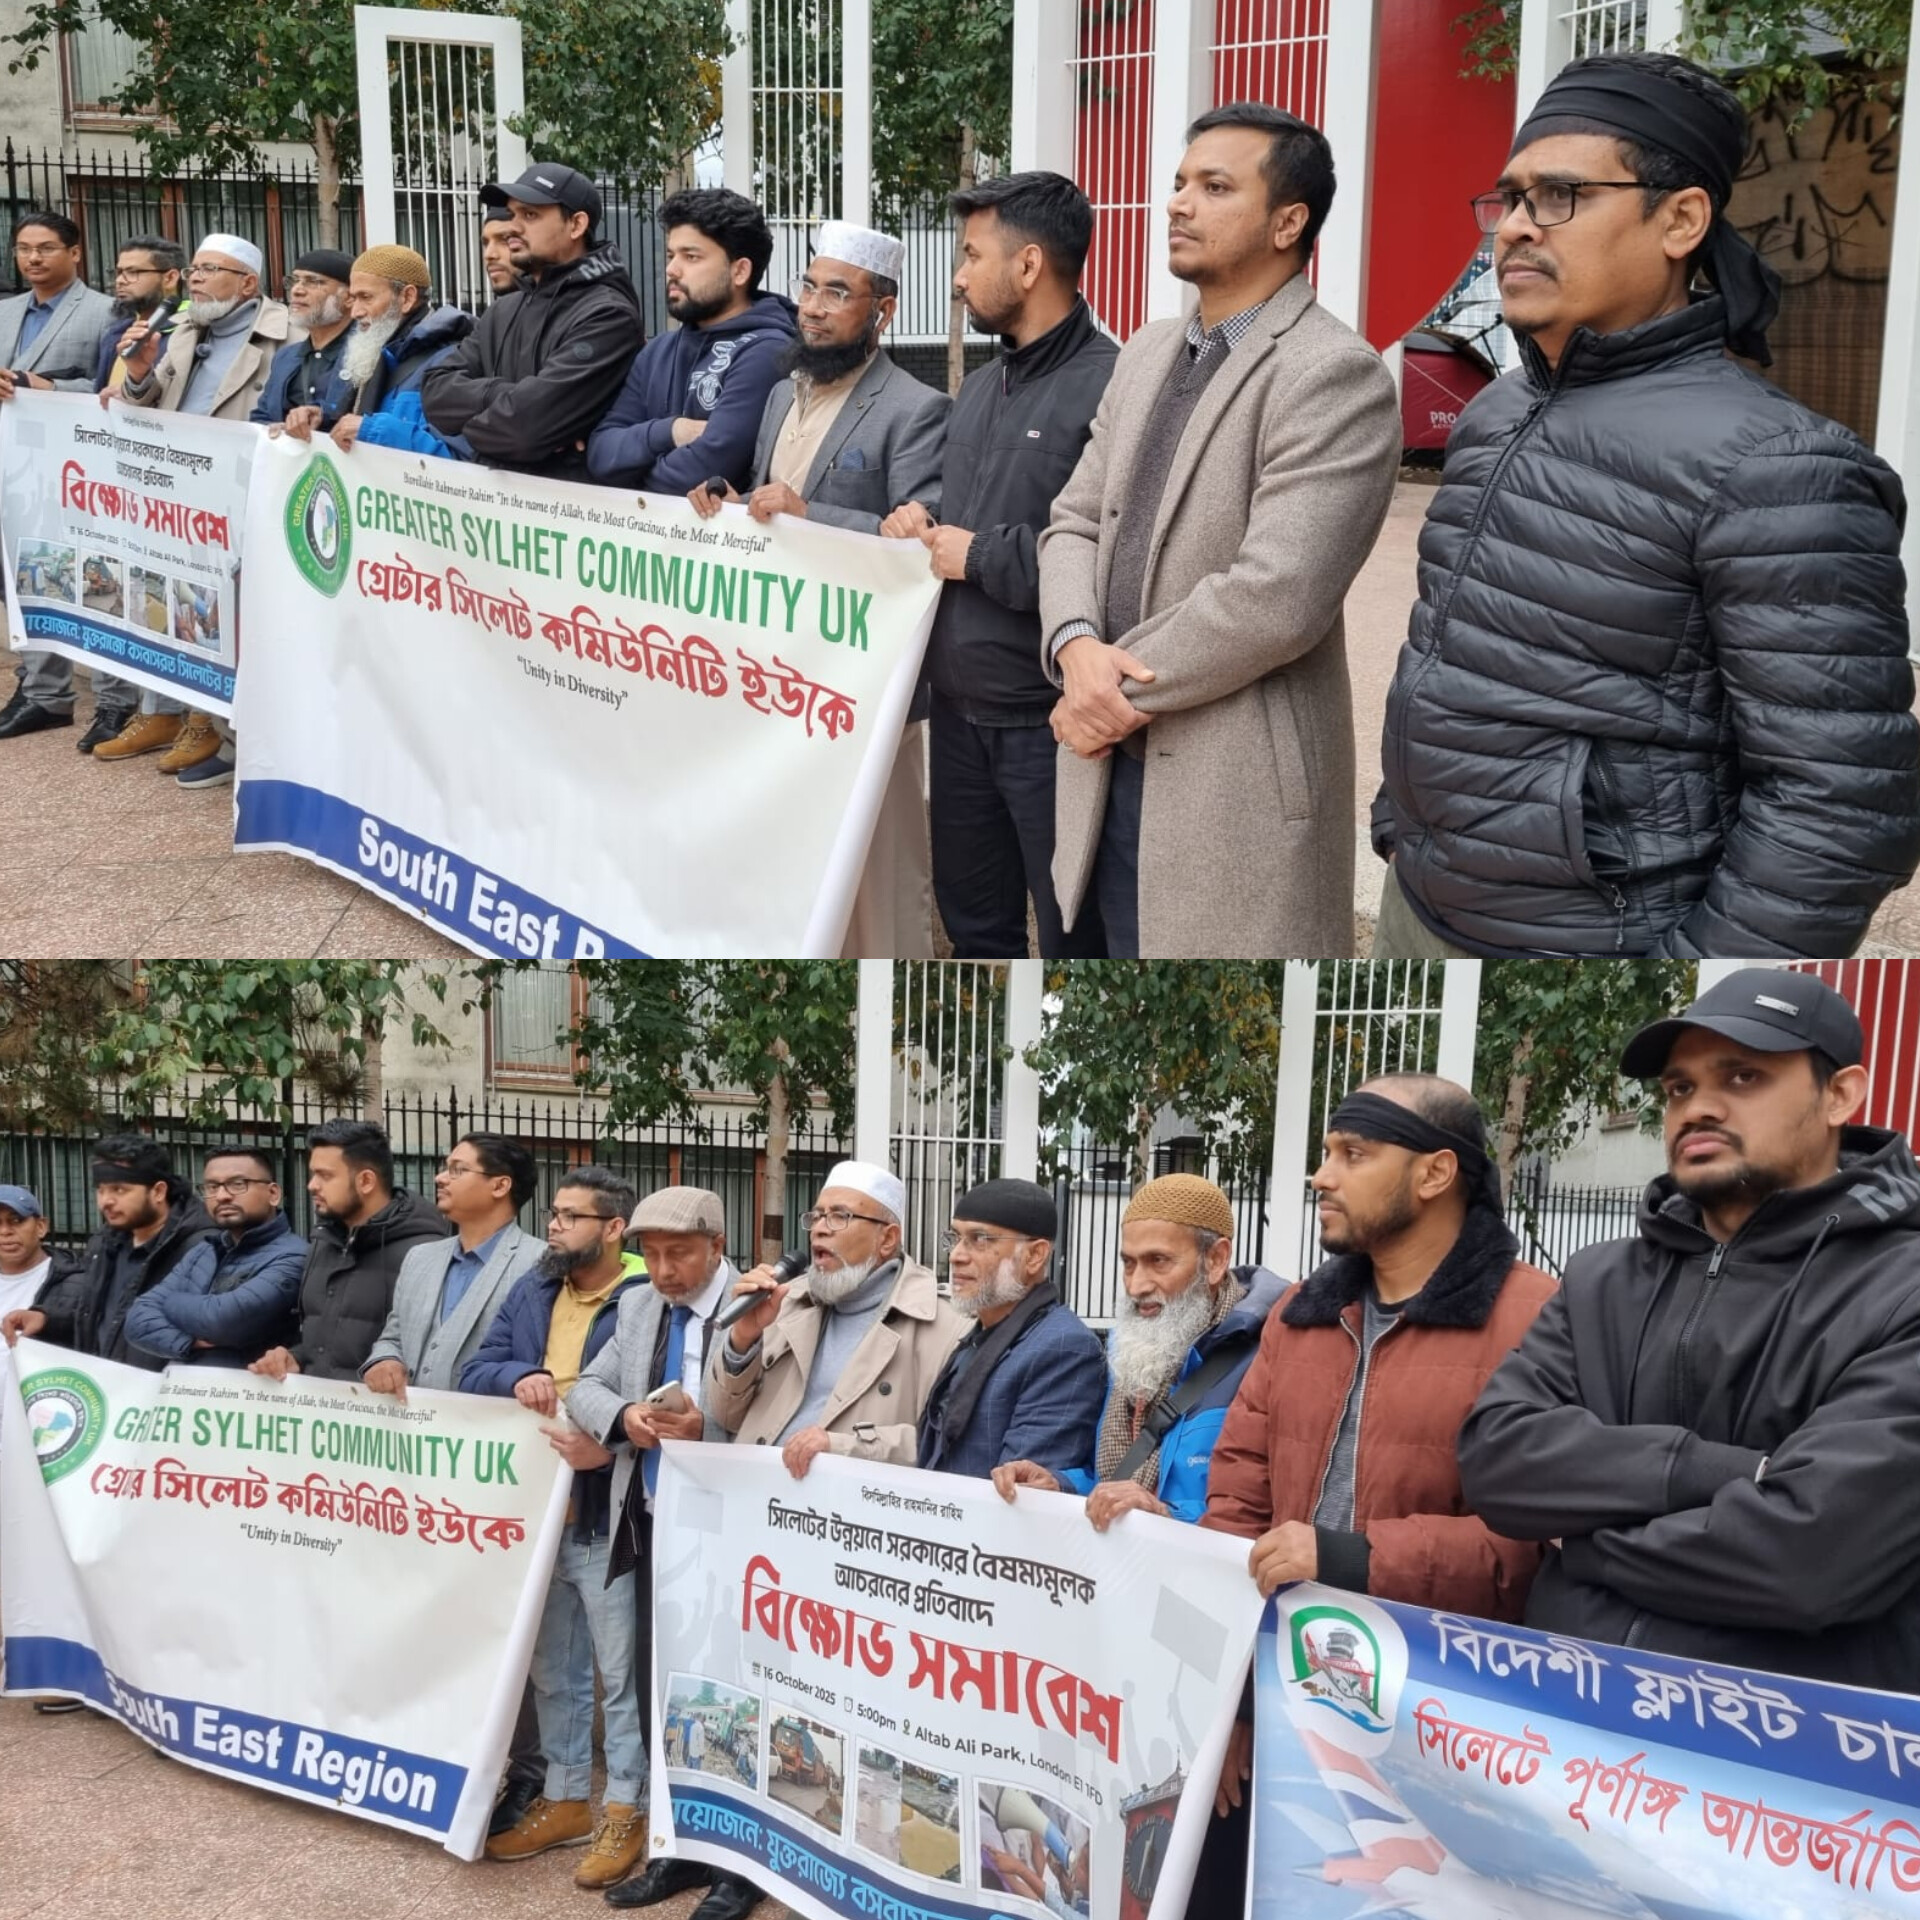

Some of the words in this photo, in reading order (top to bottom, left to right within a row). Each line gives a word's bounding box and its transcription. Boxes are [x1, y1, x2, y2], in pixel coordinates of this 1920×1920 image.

[1429, 410, 1457, 424] PRO
[144, 495, 229, 550] সমাবেশ
[468, 487, 494, 504] Rahim
[510, 493, 523, 509] the
[525, 499, 549, 514] name
[549, 501, 560, 519] of
[560, 503, 586, 521] Allah,
[587, 508, 601, 523] the
[603, 510, 626, 528] Most
[627, 515, 667, 539] Gracious,
[670, 524, 688, 541] the
[690, 526, 718, 545] Most
[356, 485, 458, 552] GREATER
[460, 512, 568, 580] SYLHET
[577, 536, 806, 633] COMMUNITY
[818, 582, 874, 652] UK
[177, 653, 222, 691] সিলেটের
[356, 552, 443, 612] গ্রেটার
[445, 566, 534, 641] সিলেট
[538, 604, 729, 698] কমিউনিটি
[736, 646, 857, 741] ইউকে
[554, 670, 566, 689] in
[567, 674, 629, 711] Diversity”
[358, 817, 458, 912] South
[468, 870, 561, 959] East
[210, 1386, 239, 1400] Rahim
[256, 1389, 269, 1402] the
[288, 1392, 298, 1408] of
[318, 1396, 329, 1409] the
[192, 1408, 303, 1455] SYLHET
[311, 1419, 465, 1480] COMMUNITY
[474, 1439, 519, 1486] UK
[153, 1457, 269, 1510] সিলেট
[276, 1472, 409, 1536] কমিউনিটি
[414, 1494, 526, 1554] ইউকে
[280, 1529, 292, 1545] in
[293, 1530, 343, 1556] Diversity”
[940, 1502, 963, 1521] রাহিম
[767, 1498, 828, 1541] সিলেটের
[830, 1514, 883, 1554] উন্নয়নে
[886, 1531, 968, 1576] সরকারের
[972, 1542, 1096, 1607] বৈষম্যমূলক
[834, 1562, 911, 1606] আচরনের
[913, 1579, 995, 1628] প্রতিবাদে
[741, 1554, 897, 1678] বিক্ষোভ
[908, 1630, 1124, 1765] সমাবেশ
[1429, 1612, 1611, 1705] বিদেশী
[1623, 1664, 1806, 1748] ফ্লাইট
[104, 1669, 180, 1742] South
[192, 1705, 284, 1771] East
[292, 1729, 438, 1813] Region
[763, 1666, 774, 1681] 16
[776, 1671, 814, 1695] October
[814, 1685, 837, 1706] 2025
[857, 1703, 897, 1731] 5:00pm
[915, 1726, 951, 1749] Altab
[954, 1738, 976, 1755] Ali
[981, 1742, 1026, 1766] Park,
[1030, 1752, 1072, 1784] London
[1412, 1697, 1552, 1786] সিলেটে
[1563, 1751, 1690, 1833] পূর্ণাঙ্গ
